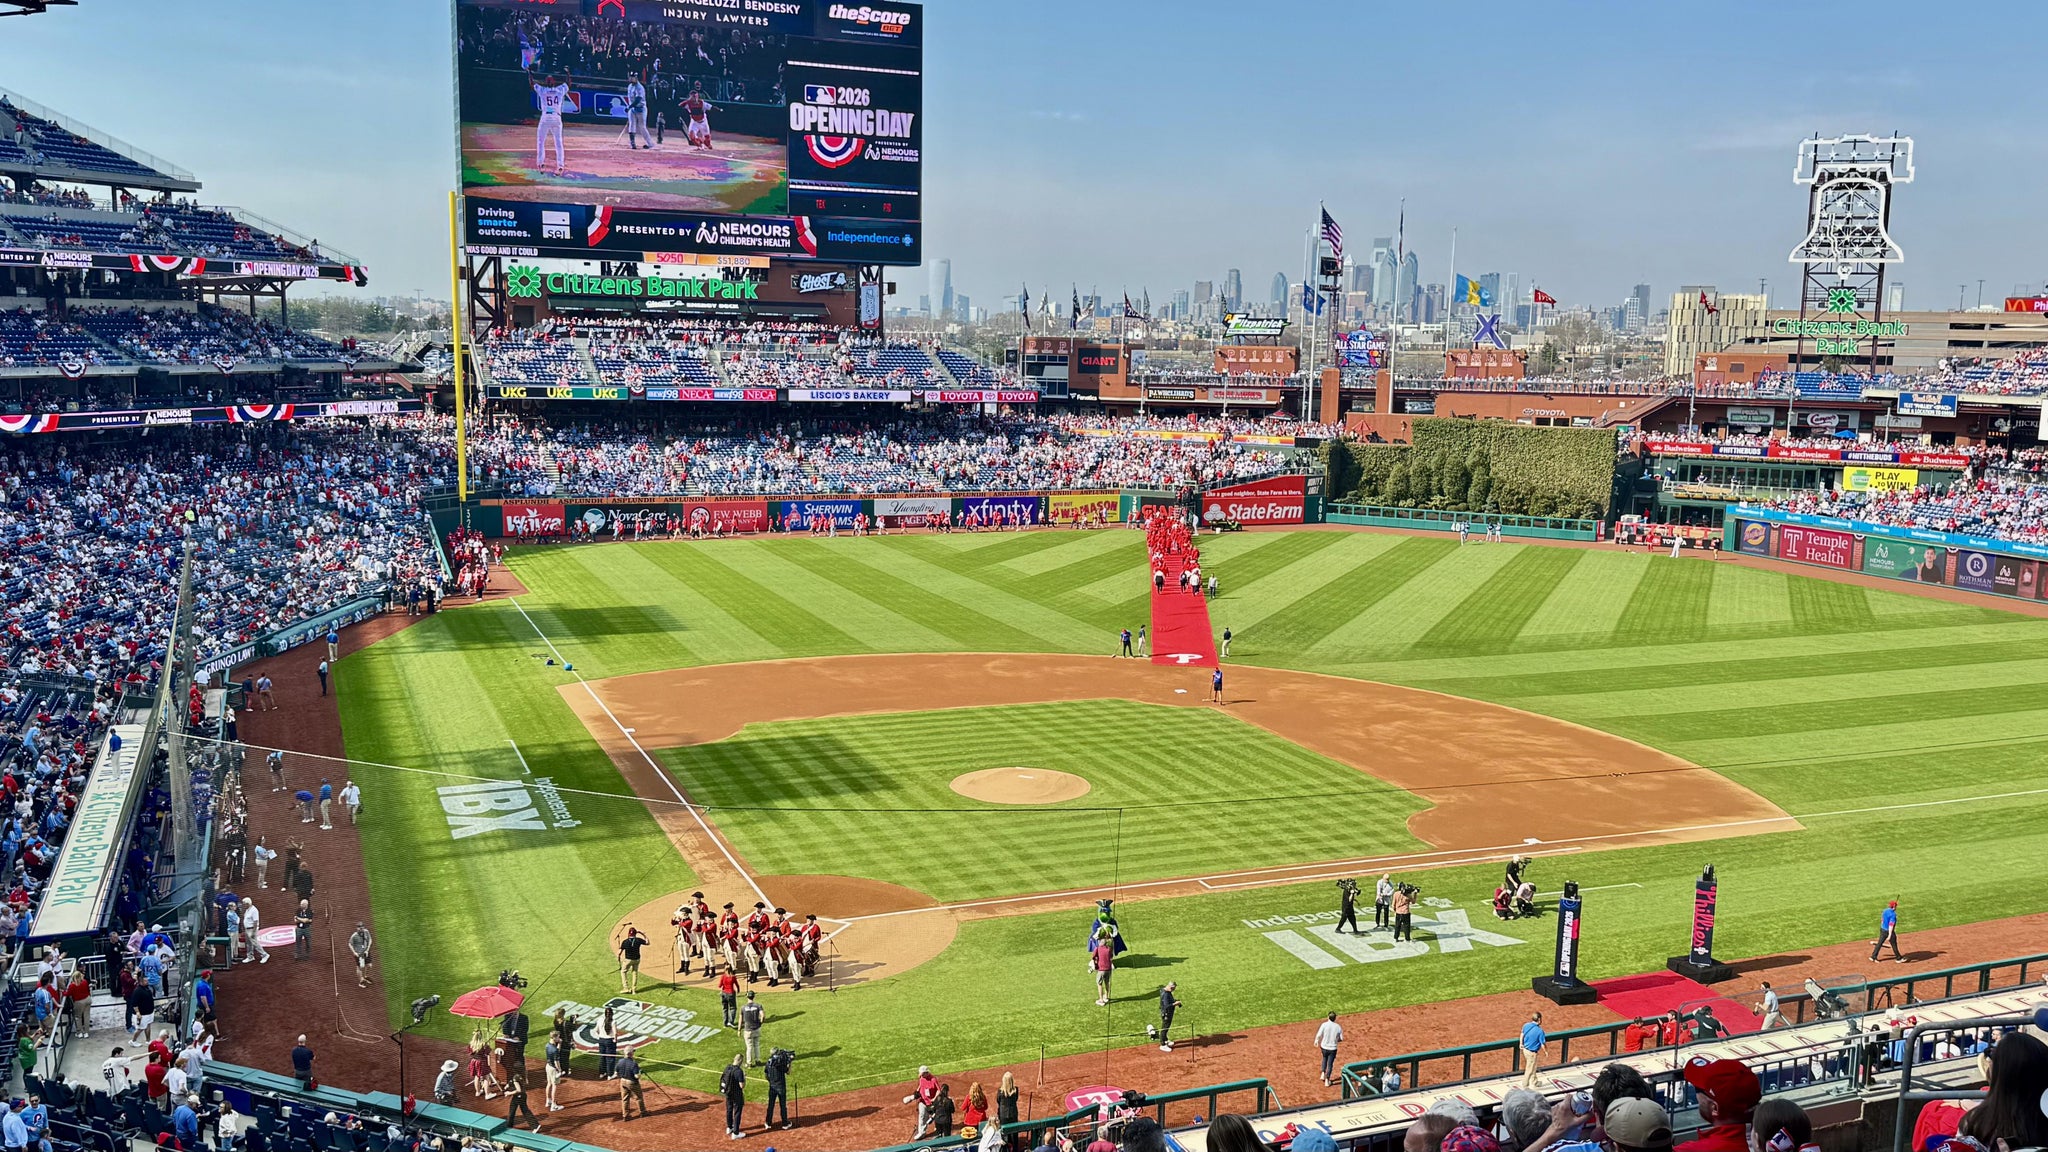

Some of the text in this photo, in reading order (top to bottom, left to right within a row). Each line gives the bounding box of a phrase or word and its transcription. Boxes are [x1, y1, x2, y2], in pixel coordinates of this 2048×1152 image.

[745, 1, 800, 15] BENDESKY
[663, 8, 769, 26] INJURY LAWYERS
[829, 4, 910, 25] theScore
[838, 87, 870, 106] 2026
[790, 102, 914, 138] OPENING DAY
[478, 207, 515, 219] Driving
[478, 218, 518, 228] smarter
[478, 227, 531, 238] outcomes.
[615, 225, 675, 236] PRESENTED
[720, 222, 790, 237] NEMOURS
[719, 237, 790, 248] CHILDREN'S HEALTH
[828, 231, 900, 244] Independence
[466, 245, 480, 254] WAS
[481, 246, 498, 255] GOOD
[499, 247, 511, 255] AND
[518, 247, 538, 256] COULD
[53, 252, 92, 261] NEMOURS
[253, 262, 319, 277] OPENING DAY 2026
[547, 272, 758, 299] Citizens Bank Park
[799, 272, 837, 293] GHOST
[1774, 317, 1907, 336] Citizens Bank
[1367, 340, 1386, 350] GAME
[1815, 337, 1859, 355] Park
[1081, 356, 1116, 366] GIANT
[501, 387, 527, 398] UKG
[547, 387, 573, 398] UKG
[592, 388, 618, 399] UKG
[682, 389, 711, 399] NECA
[747, 389, 775, 400] NECA
[810, 391, 890, 400] LISCIO'S BAKERY
[943, 392, 979, 400] TOYOTA
[1001, 392, 1036, 401] TOYOTA
[157, 409, 192, 418] NEMOURS
[1664, 444, 1702, 453] Budweiser
[1719, 446, 1761, 455] #HITTHEBUDS
[1790, 450, 1830, 459] Budweiser
[1848, 452, 1892, 461] #HITTHEBUDS
[1923, 456, 1965, 465] Budweiser
[1875, 472, 1900, 480] PLAY
[804, 503, 853, 514] SHERWIN
[889, 501, 938, 515] Yuengling
[1806, 531, 1848, 550] Temple
[1805, 548, 1845, 565] Health
[1958, 574, 1992, 585] ROTHMAN
[205, 653, 236, 674] GRUNGO
[436, 780, 548, 840] IBX
[51, 800, 121, 907] Citizens Bank Park
[1692, 886, 1717, 948] Phillies
[1261, 908, 1528, 970] IBX
[653, 1004, 698, 1021] 2026
[656, 1020, 722, 1044] DAY
[1347, 1112, 1387, 1126] OF THE
